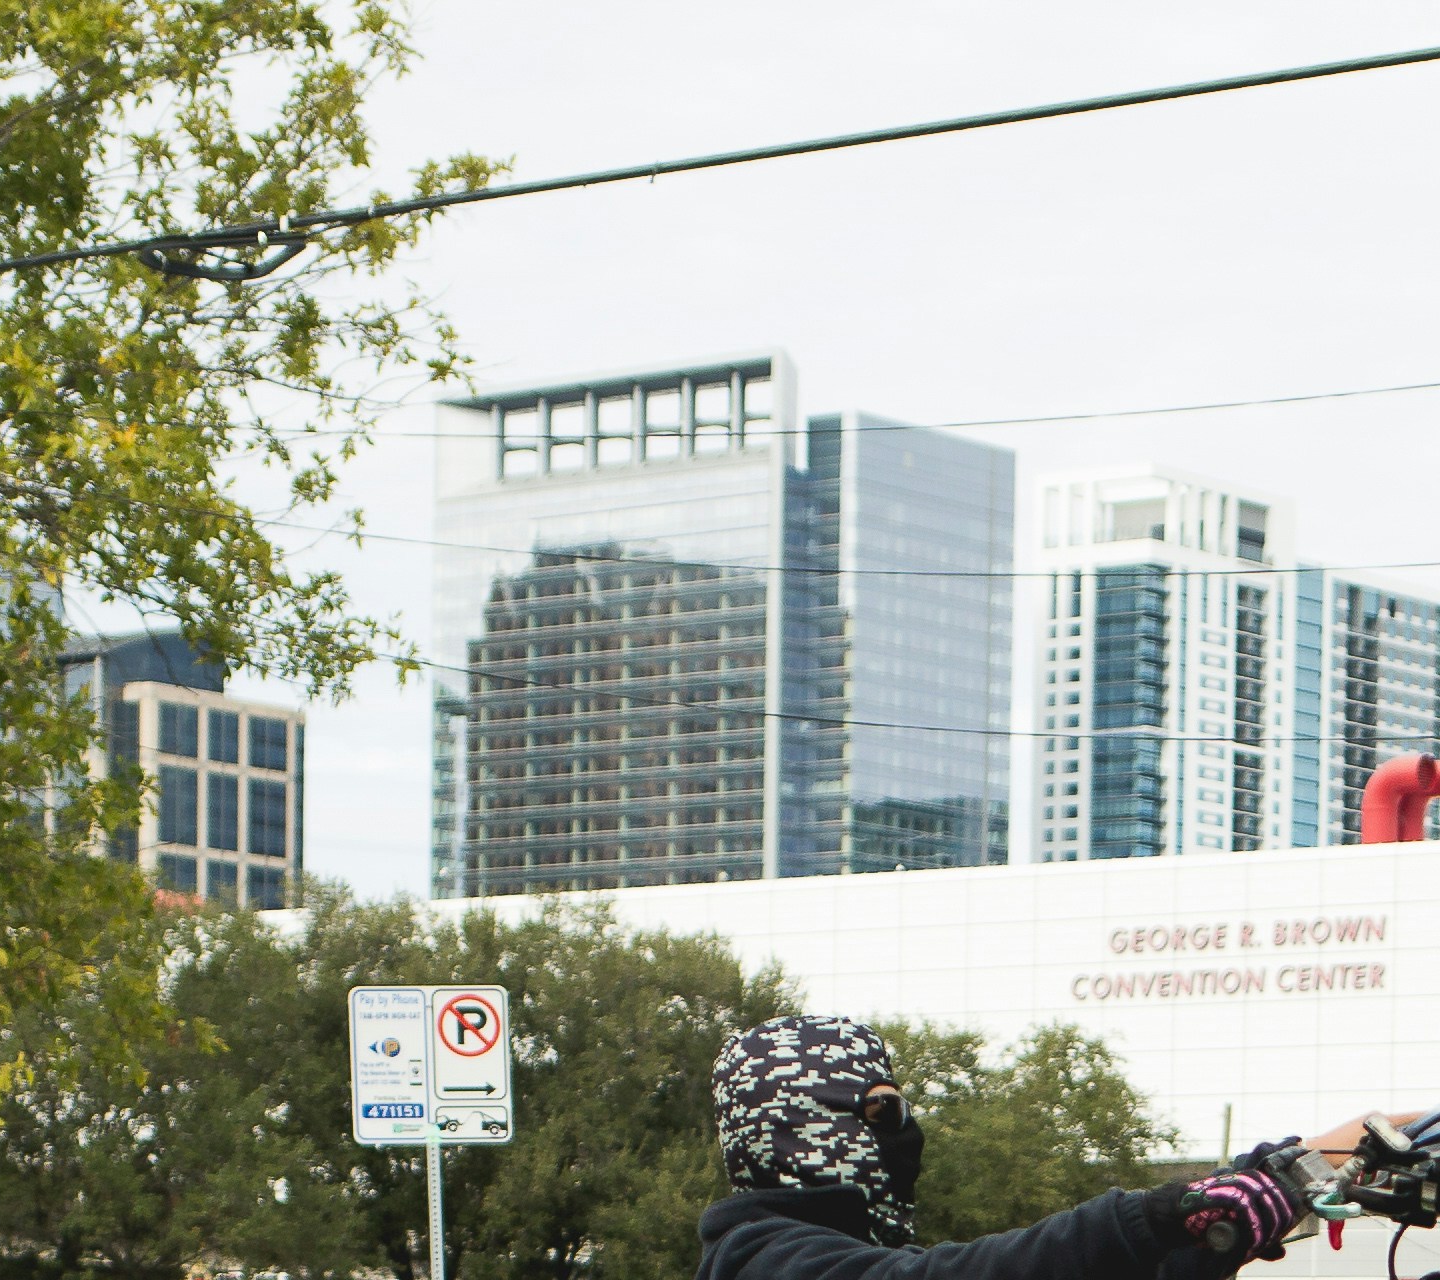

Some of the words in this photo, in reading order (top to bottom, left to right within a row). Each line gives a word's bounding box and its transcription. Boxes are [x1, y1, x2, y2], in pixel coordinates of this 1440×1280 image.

[1109, 922, 1227, 953] GEORGE
[1239, 920, 1261, 949] R.
[1272, 915, 1387, 946] BROWN
[1071, 967, 1266, 1000] CONVENTION
[1277, 963, 1386, 992] CENTER
[368, 1105, 421, 1117] 471151
